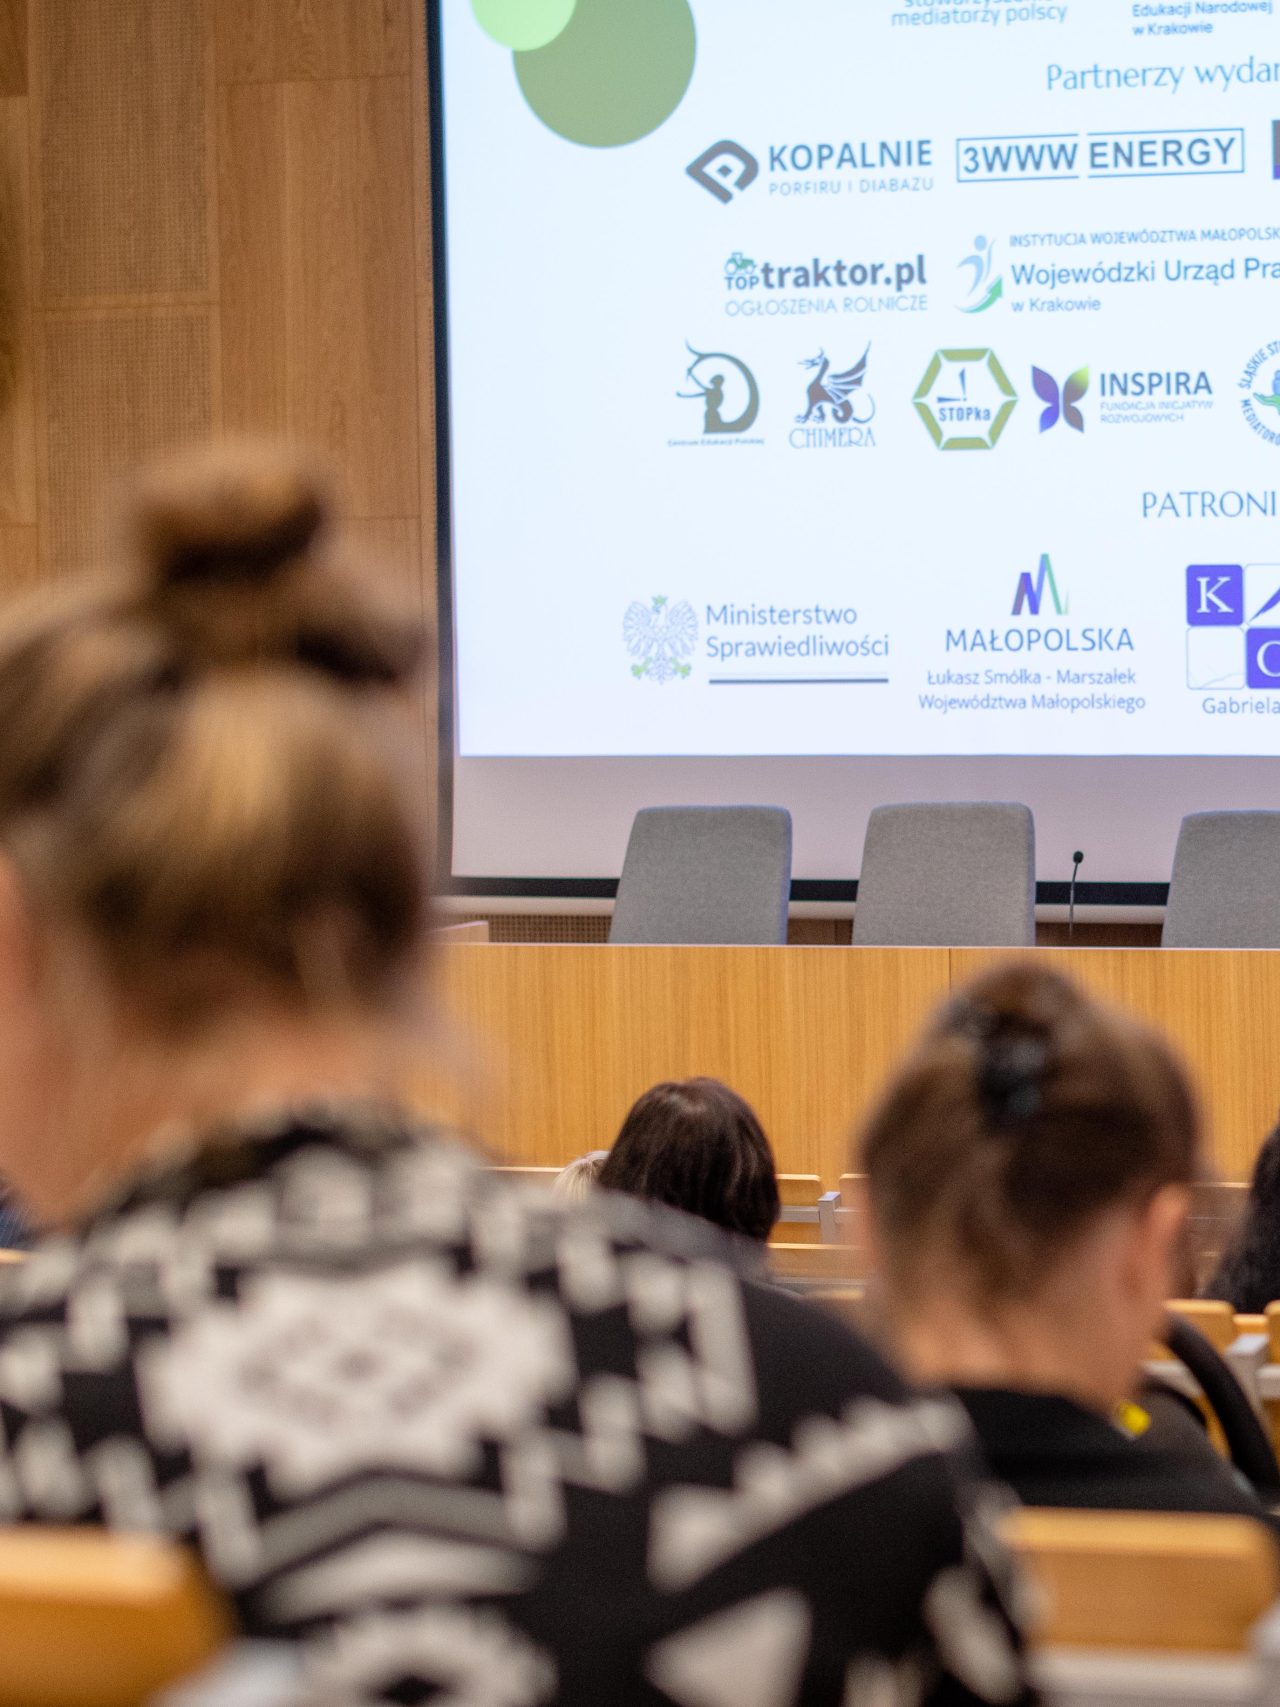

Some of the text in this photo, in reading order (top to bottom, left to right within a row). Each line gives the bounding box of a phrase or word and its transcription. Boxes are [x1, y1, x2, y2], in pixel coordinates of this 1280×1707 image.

[891, 9, 1000, 27] mediatorzy
[1005, 4, 1068, 24] polscy
[1131, 0, 1273, 18] Edukacji Narodowej
[1132, 20, 1215, 36] w Krakowie
[1046, 63, 1185, 95] Partnerzy
[768, 138, 933, 173] KOPALNIE
[962, 137, 1236, 174] 3WWW ENERGY
[767, 179, 842, 197] PORFIRU
[858, 177, 934, 194] DIABAZU
[1008, 231, 1088, 248] INSTYTUCJA
[1089, 227, 1198, 245] WOJEWÓDZTWA
[723, 254, 927, 291] TOP traktor.pl
[1010, 259, 1156, 289] Wojewódzki
[1163, 257, 1236, 287] Urząd
[724, 292, 929, 318] OGŁOSZENIA ROLNICZE
[1010, 296, 1102, 313] w Krakowie
[1238, 348, 1268, 389] ŚLĄSKIE
[1099, 370, 1214, 398] INSPIRA
[938, 406, 992, 422] STOPka
[1099, 399, 1215, 412] FUNDACJA INICJATYW
[1099, 412, 1185, 425] ROZWOJOWYCH
[788, 427, 877, 449] CHIMERA
[1141, 489, 1277, 519] PATRONI
[705, 602, 858, 626] Ministerstwo
[705, 633, 890, 663] Sprawiedliwości
[945, 627, 1135, 653] MAŁOPOLSKA
[926, 668, 981, 686] Łukasz
[983, 667, 1043, 686] Smółka
[1055, 667, 1137, 686] Marszałek
[918, 692, 1147, 715] Województwa Małopolskiego
